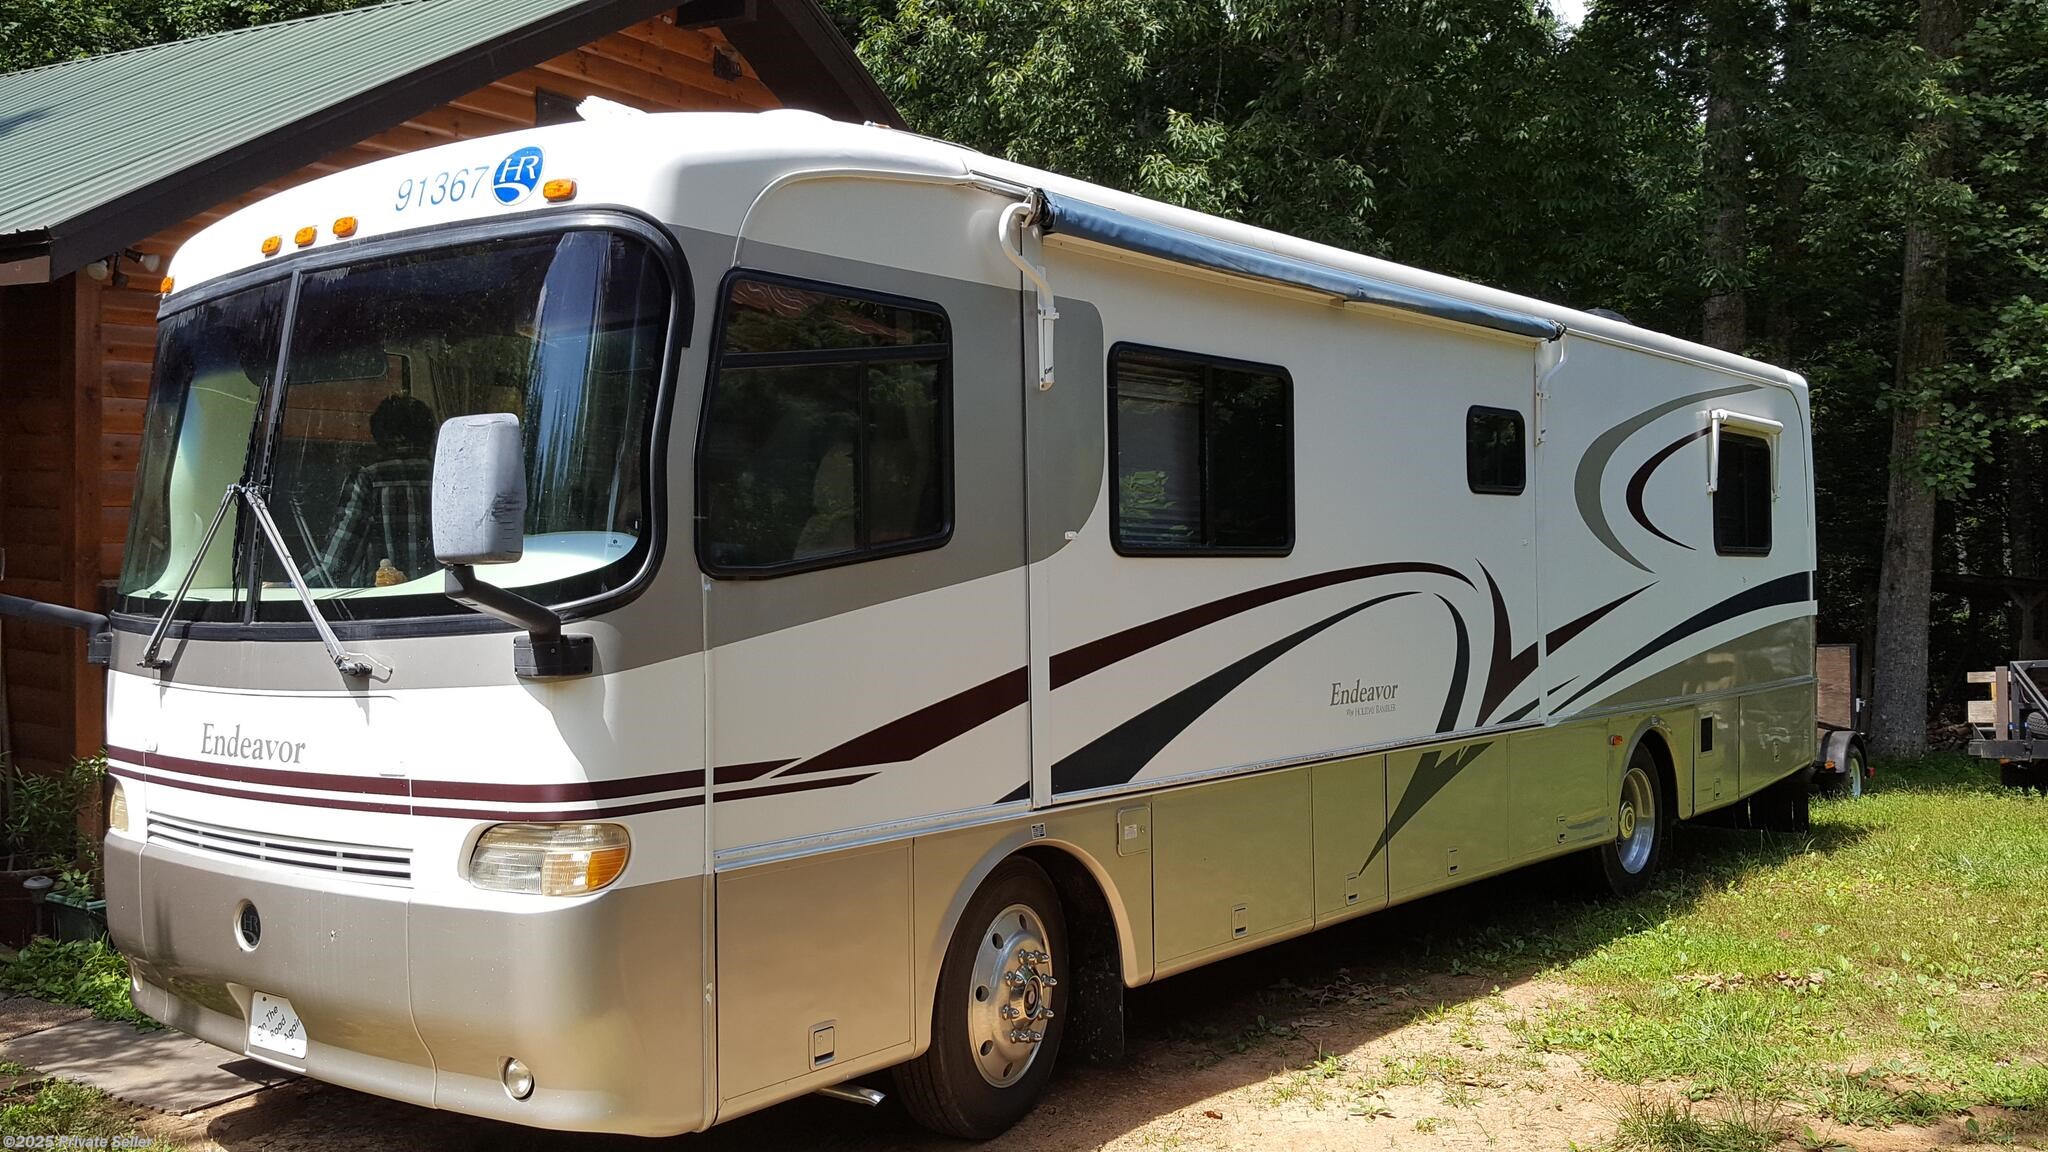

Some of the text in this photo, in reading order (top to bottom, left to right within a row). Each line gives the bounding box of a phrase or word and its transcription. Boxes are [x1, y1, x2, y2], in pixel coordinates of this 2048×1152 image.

[498, 155, 540, 184] HR
[395, 166, 490, 211] 91367
[1330, 679, 1398, 706] Endeavor
[201, 722, 306, 763] Endeavor
[266, 1006, 278, 1022] The
